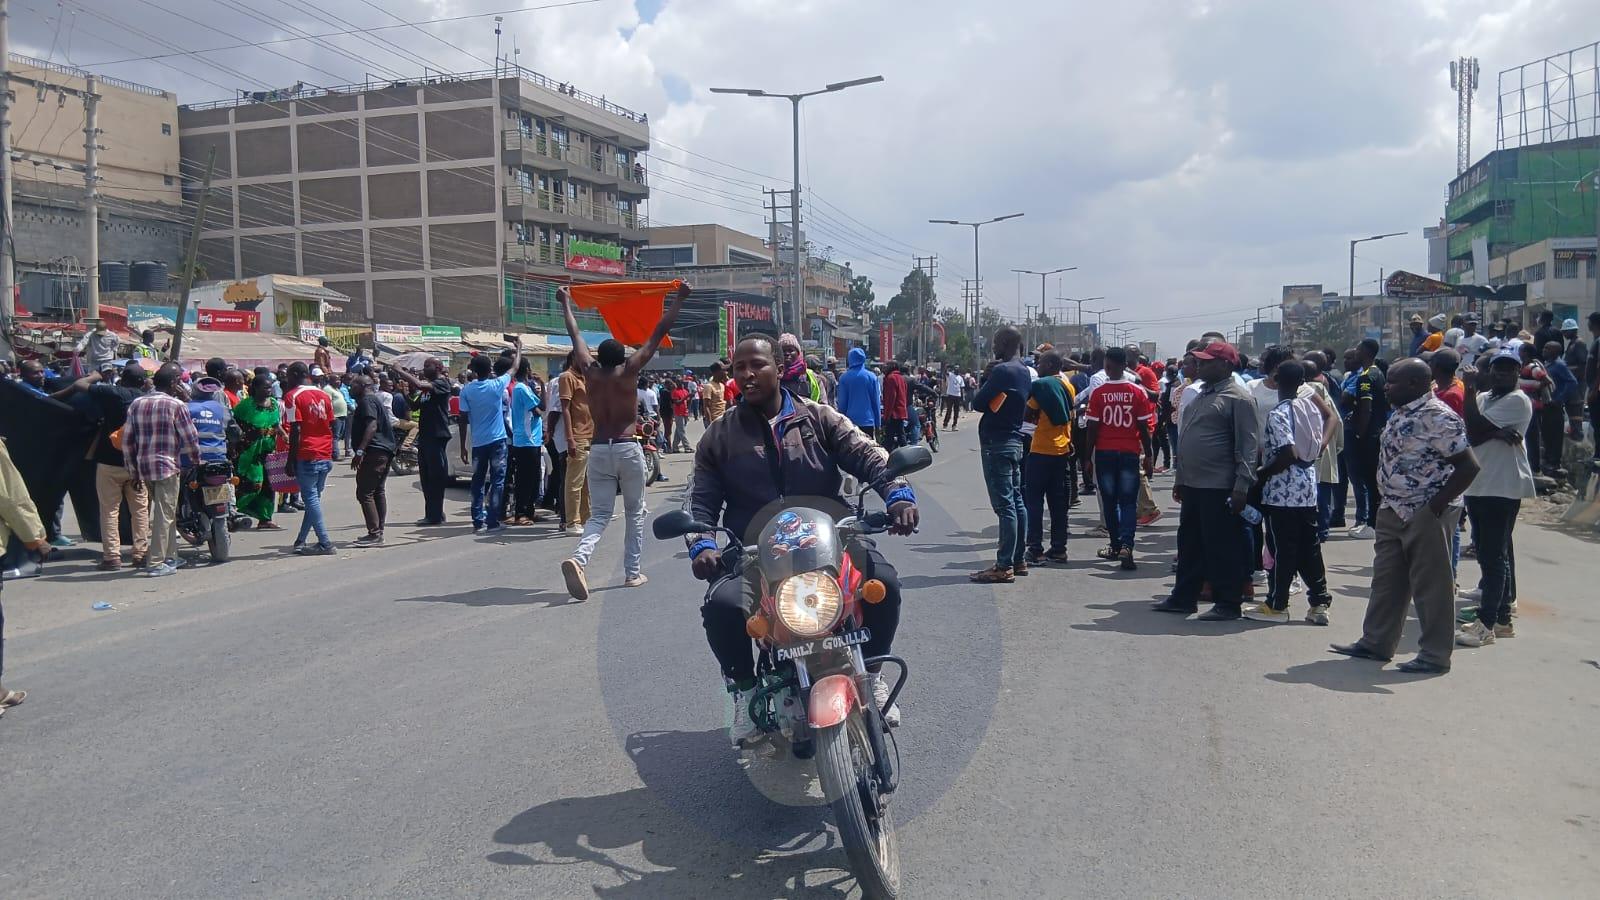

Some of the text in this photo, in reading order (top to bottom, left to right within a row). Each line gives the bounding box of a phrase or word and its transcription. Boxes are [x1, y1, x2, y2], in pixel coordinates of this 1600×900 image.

[724, 300, 771, 321] ICKMART
[1101, 392, 1134, 403] TONNEY
[1102, 405, 1133, 428] 003
[777, 627, 869, 662] FAMILY GORILLA
